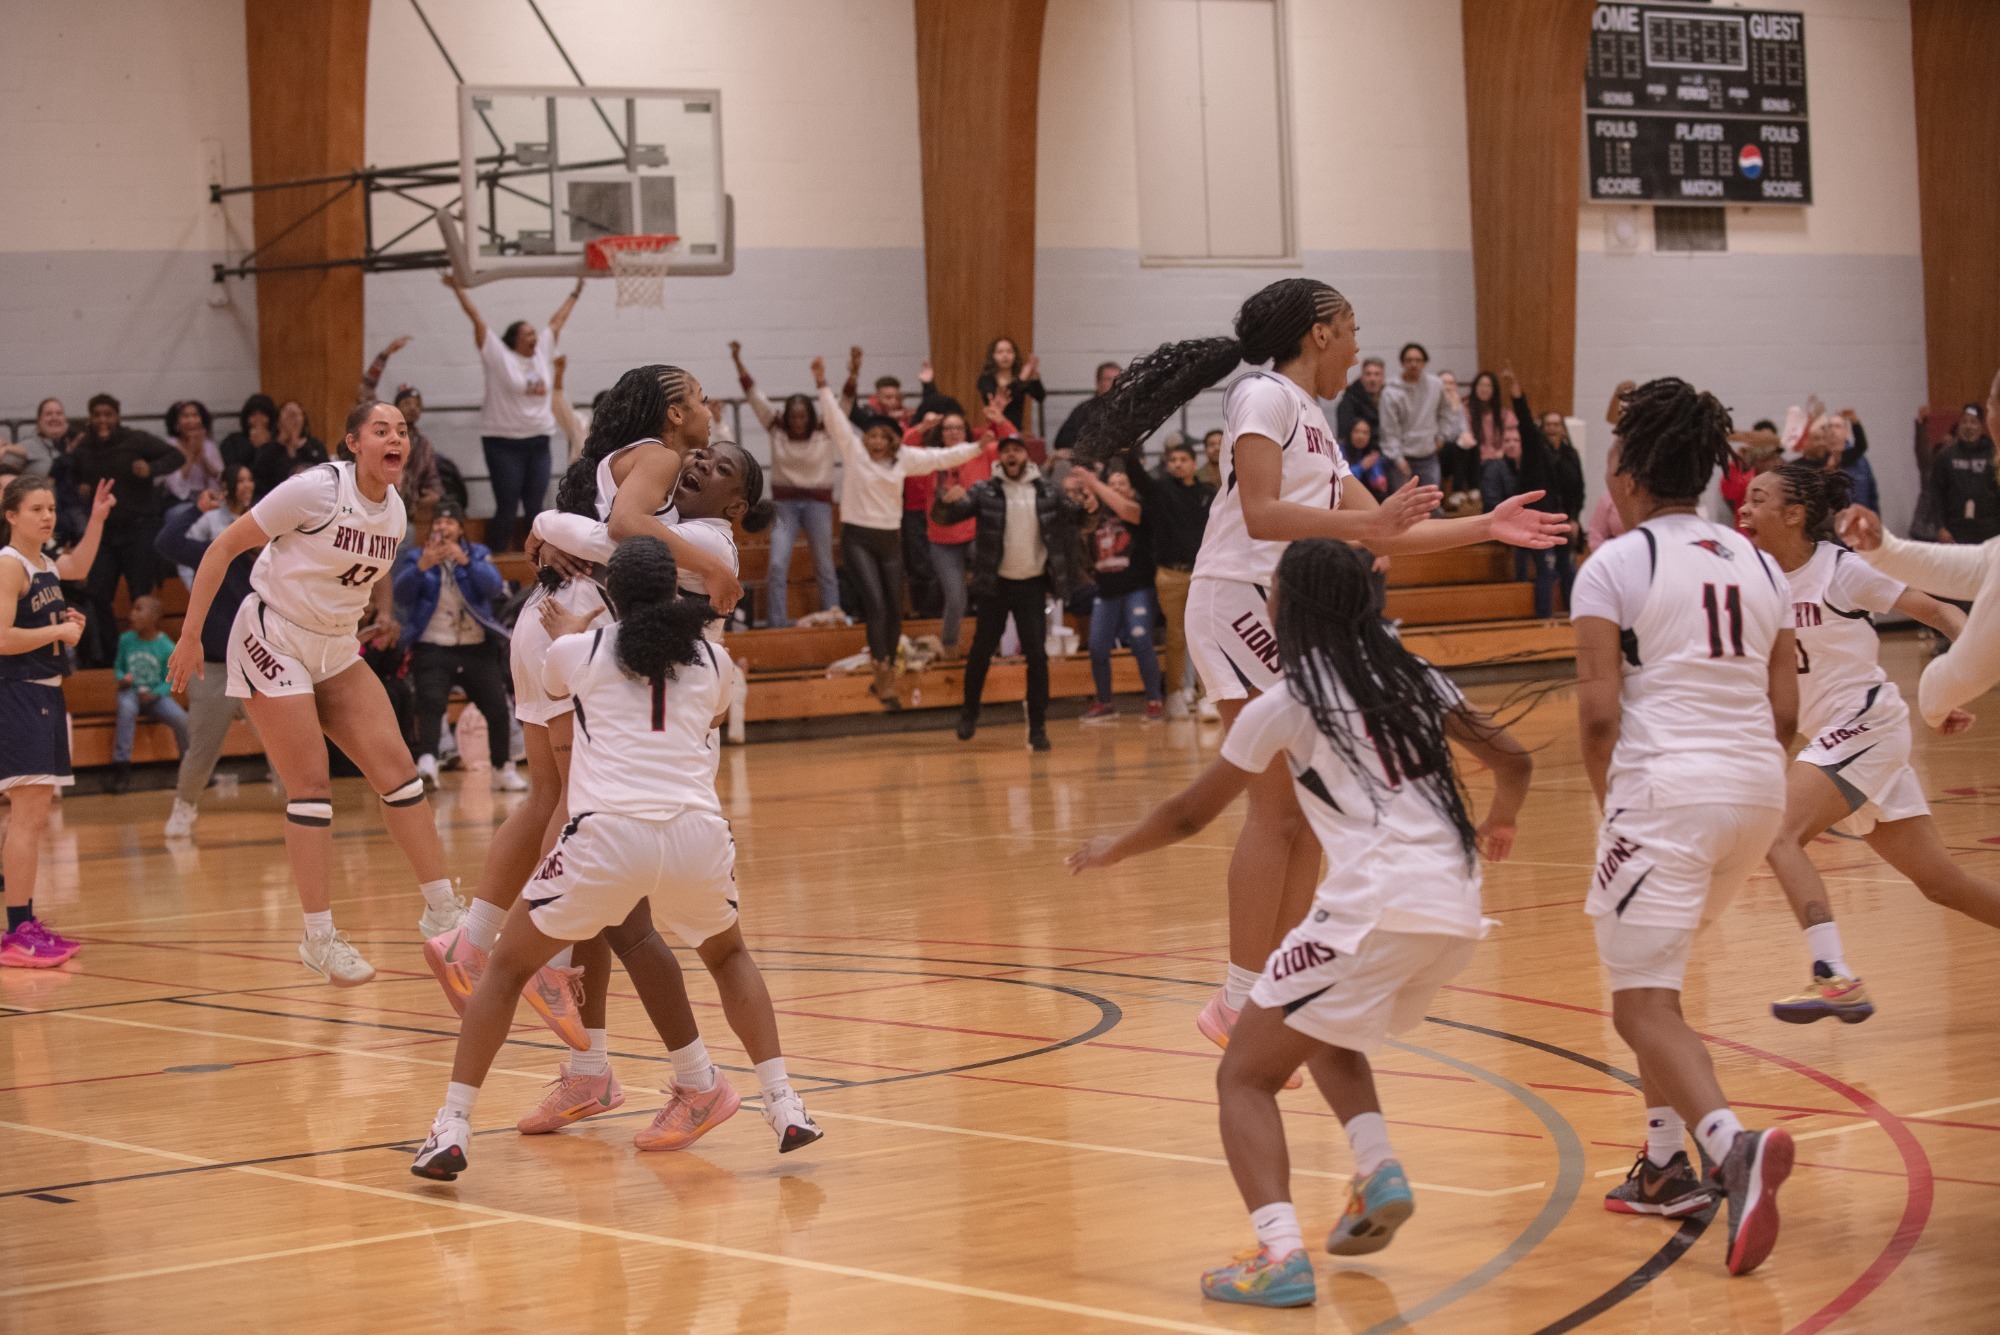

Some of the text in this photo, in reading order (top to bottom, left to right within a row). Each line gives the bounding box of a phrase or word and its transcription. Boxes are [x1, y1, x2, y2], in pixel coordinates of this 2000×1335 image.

[1750, 14, 1800, 41] GUEST
[1595, 120, 1638, 138] FOULS
[1675, 122, 1724, 141] PLAYER
[1760, 125, 1799, 143] FOULS
[1597, 177, 1642, 195] SCORE
[1680, 179, 1724, 196] MATCH
[1762, 180, 1804, 198] SCORE
[333, 525, 365, 555] BRYN
[1703, 582, 1745, 659] 11
[243, 633, 285, 681] LIONS
[1273, 942, 1337, 981] LIONS
